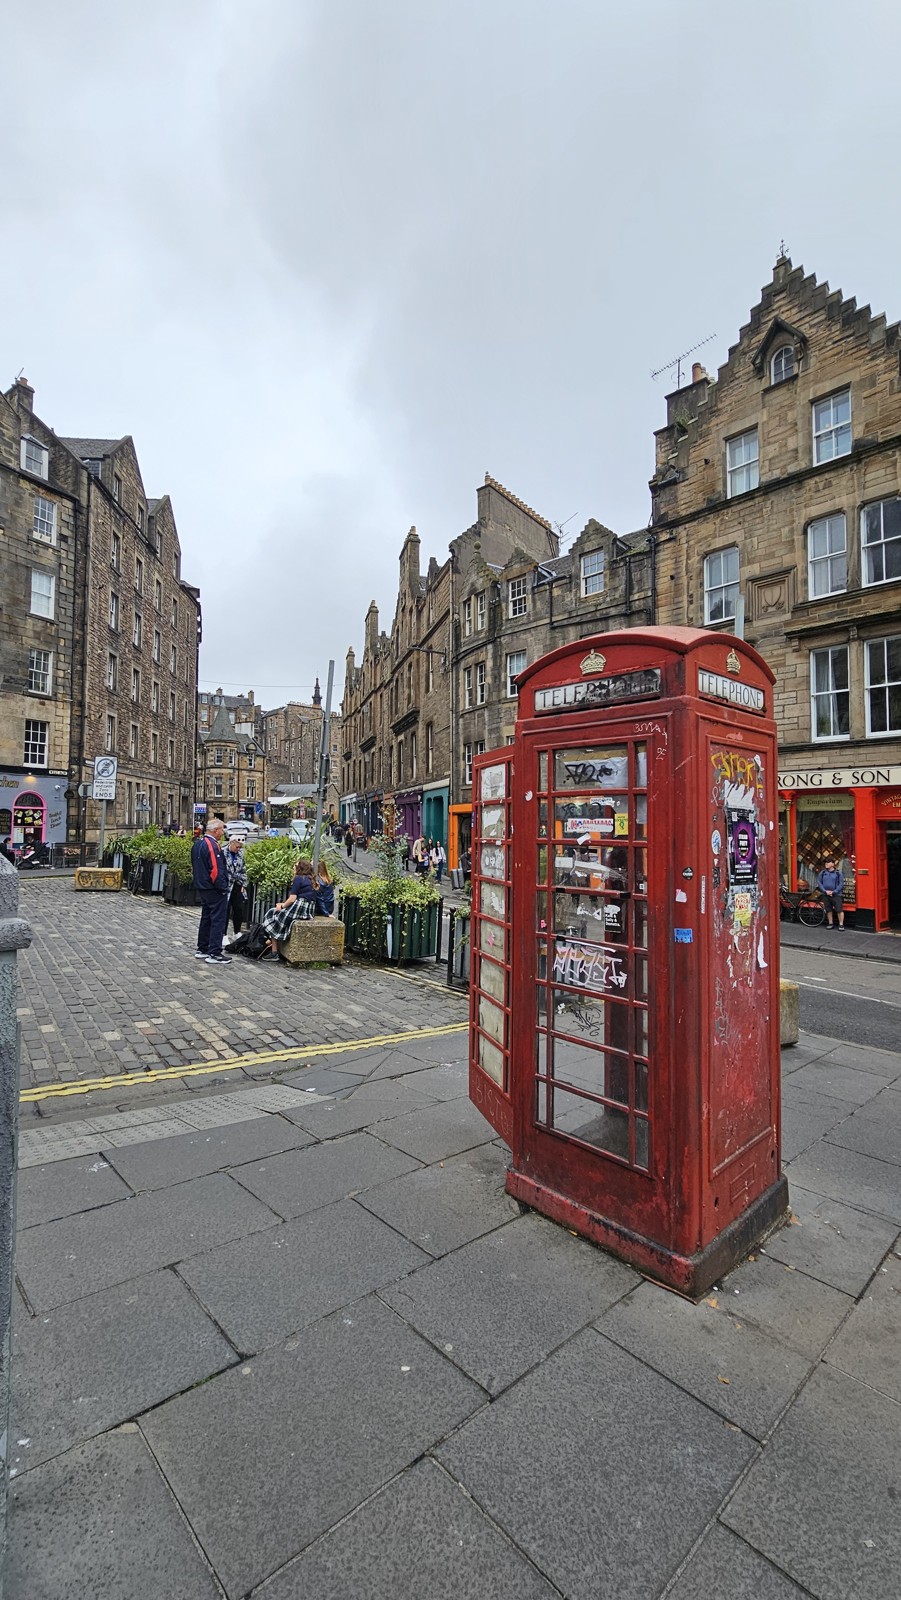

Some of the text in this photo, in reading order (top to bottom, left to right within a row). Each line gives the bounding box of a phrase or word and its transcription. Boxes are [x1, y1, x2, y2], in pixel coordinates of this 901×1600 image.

[699, 671, 762, 709] TELEPHONE
[832, 772, 843, 785] &
[852, 770, 890, 785] SON
[807, 798, 843, 806] Emporium
